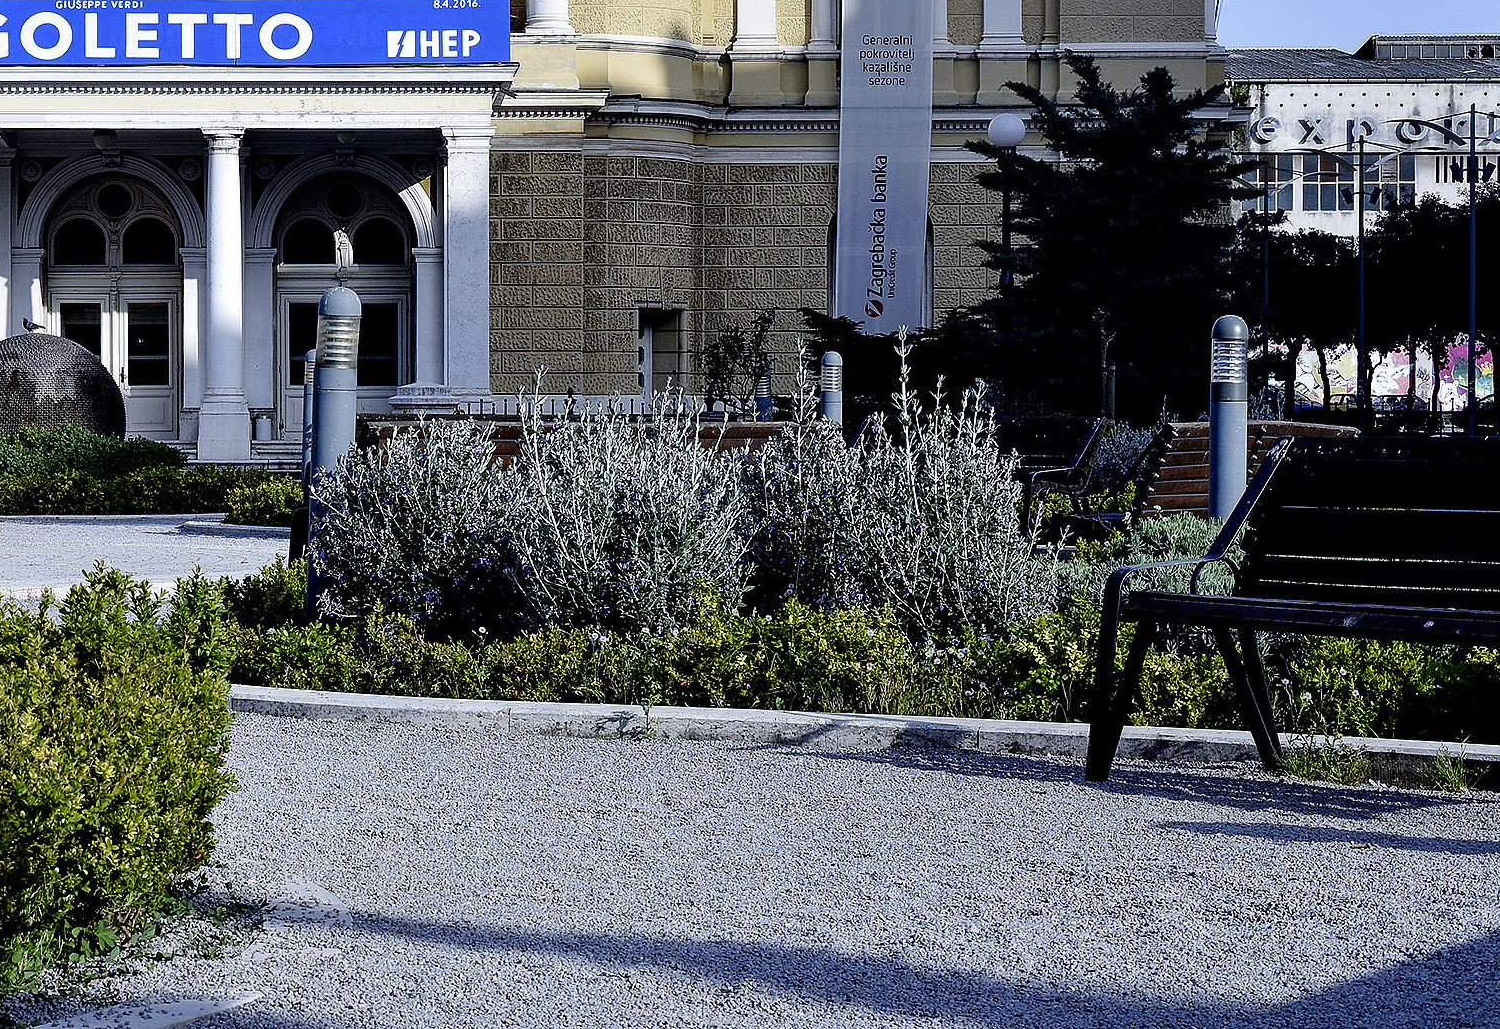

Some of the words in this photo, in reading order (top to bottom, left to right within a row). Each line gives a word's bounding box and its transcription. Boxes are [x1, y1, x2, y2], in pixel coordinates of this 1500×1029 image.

[55, 0, 107, 9] GIUSEPPE
[111, 0, 144, 9] VERDI
[419, 29, 481, 58] HEP
[862, 34, 914, 46] Generalni
[859, 48, 915, 61] pokrovitelj
[862, 61, 912, 73] kazališne
[868, 77, 906, 86] sezone
[870, 155, 888, 203] banka
[867, 207, 888, 298] Zagrebačka
[889, 248, 898, 269] Group
[887, 269, 896, 299] UniCredit
